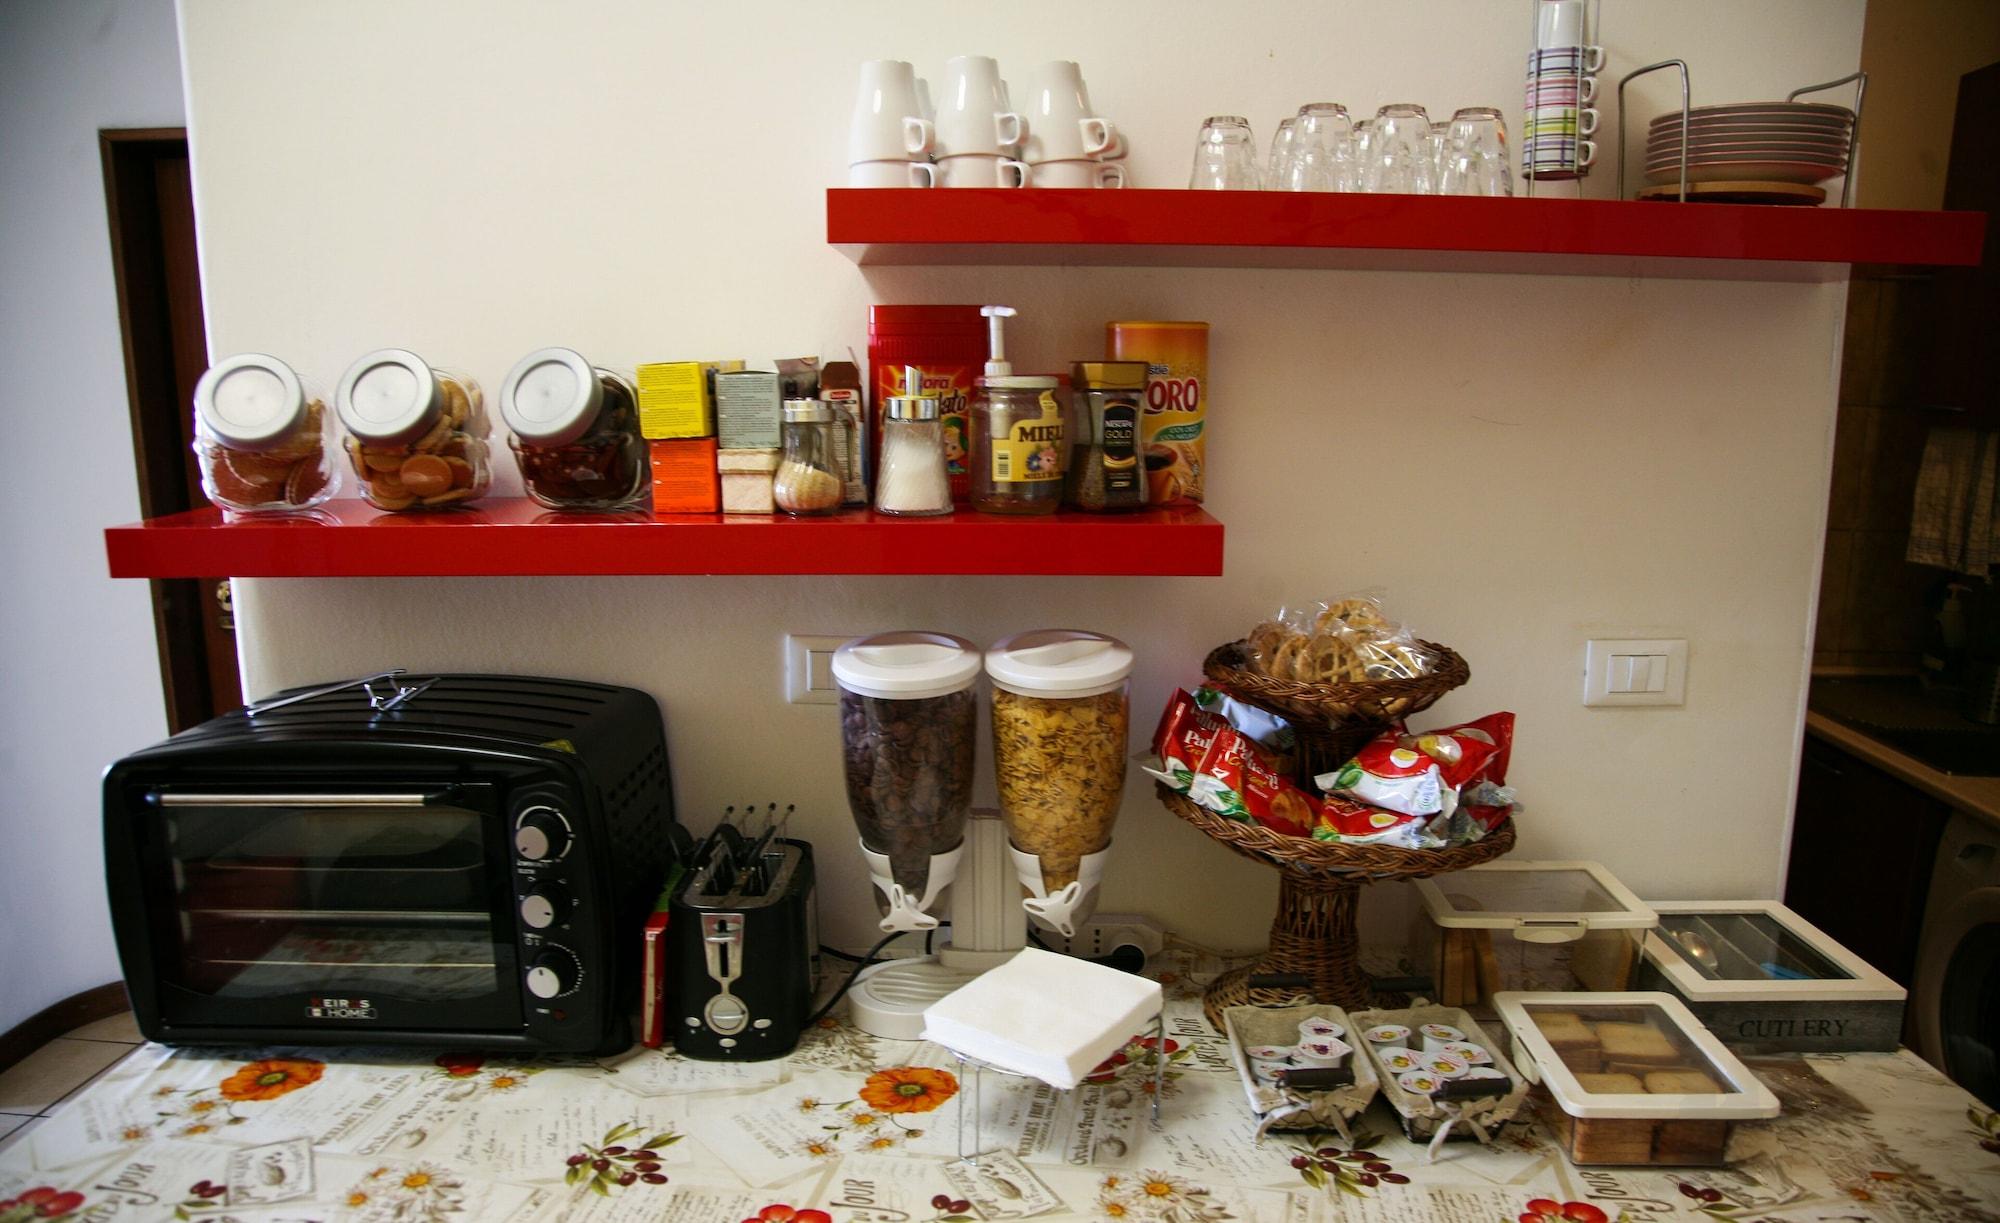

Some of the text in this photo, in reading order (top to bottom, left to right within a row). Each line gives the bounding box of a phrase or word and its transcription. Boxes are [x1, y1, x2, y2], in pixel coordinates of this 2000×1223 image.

[1144, 378, 1199, 412] ORO
[1104, 430, 1132, 439] GOLD
[1738, 1020, 1848, 1038] CUTLERY
[829, 1179, 911, 1222] JOUR
[1579, 1172, 1676, 1212] JOUR
